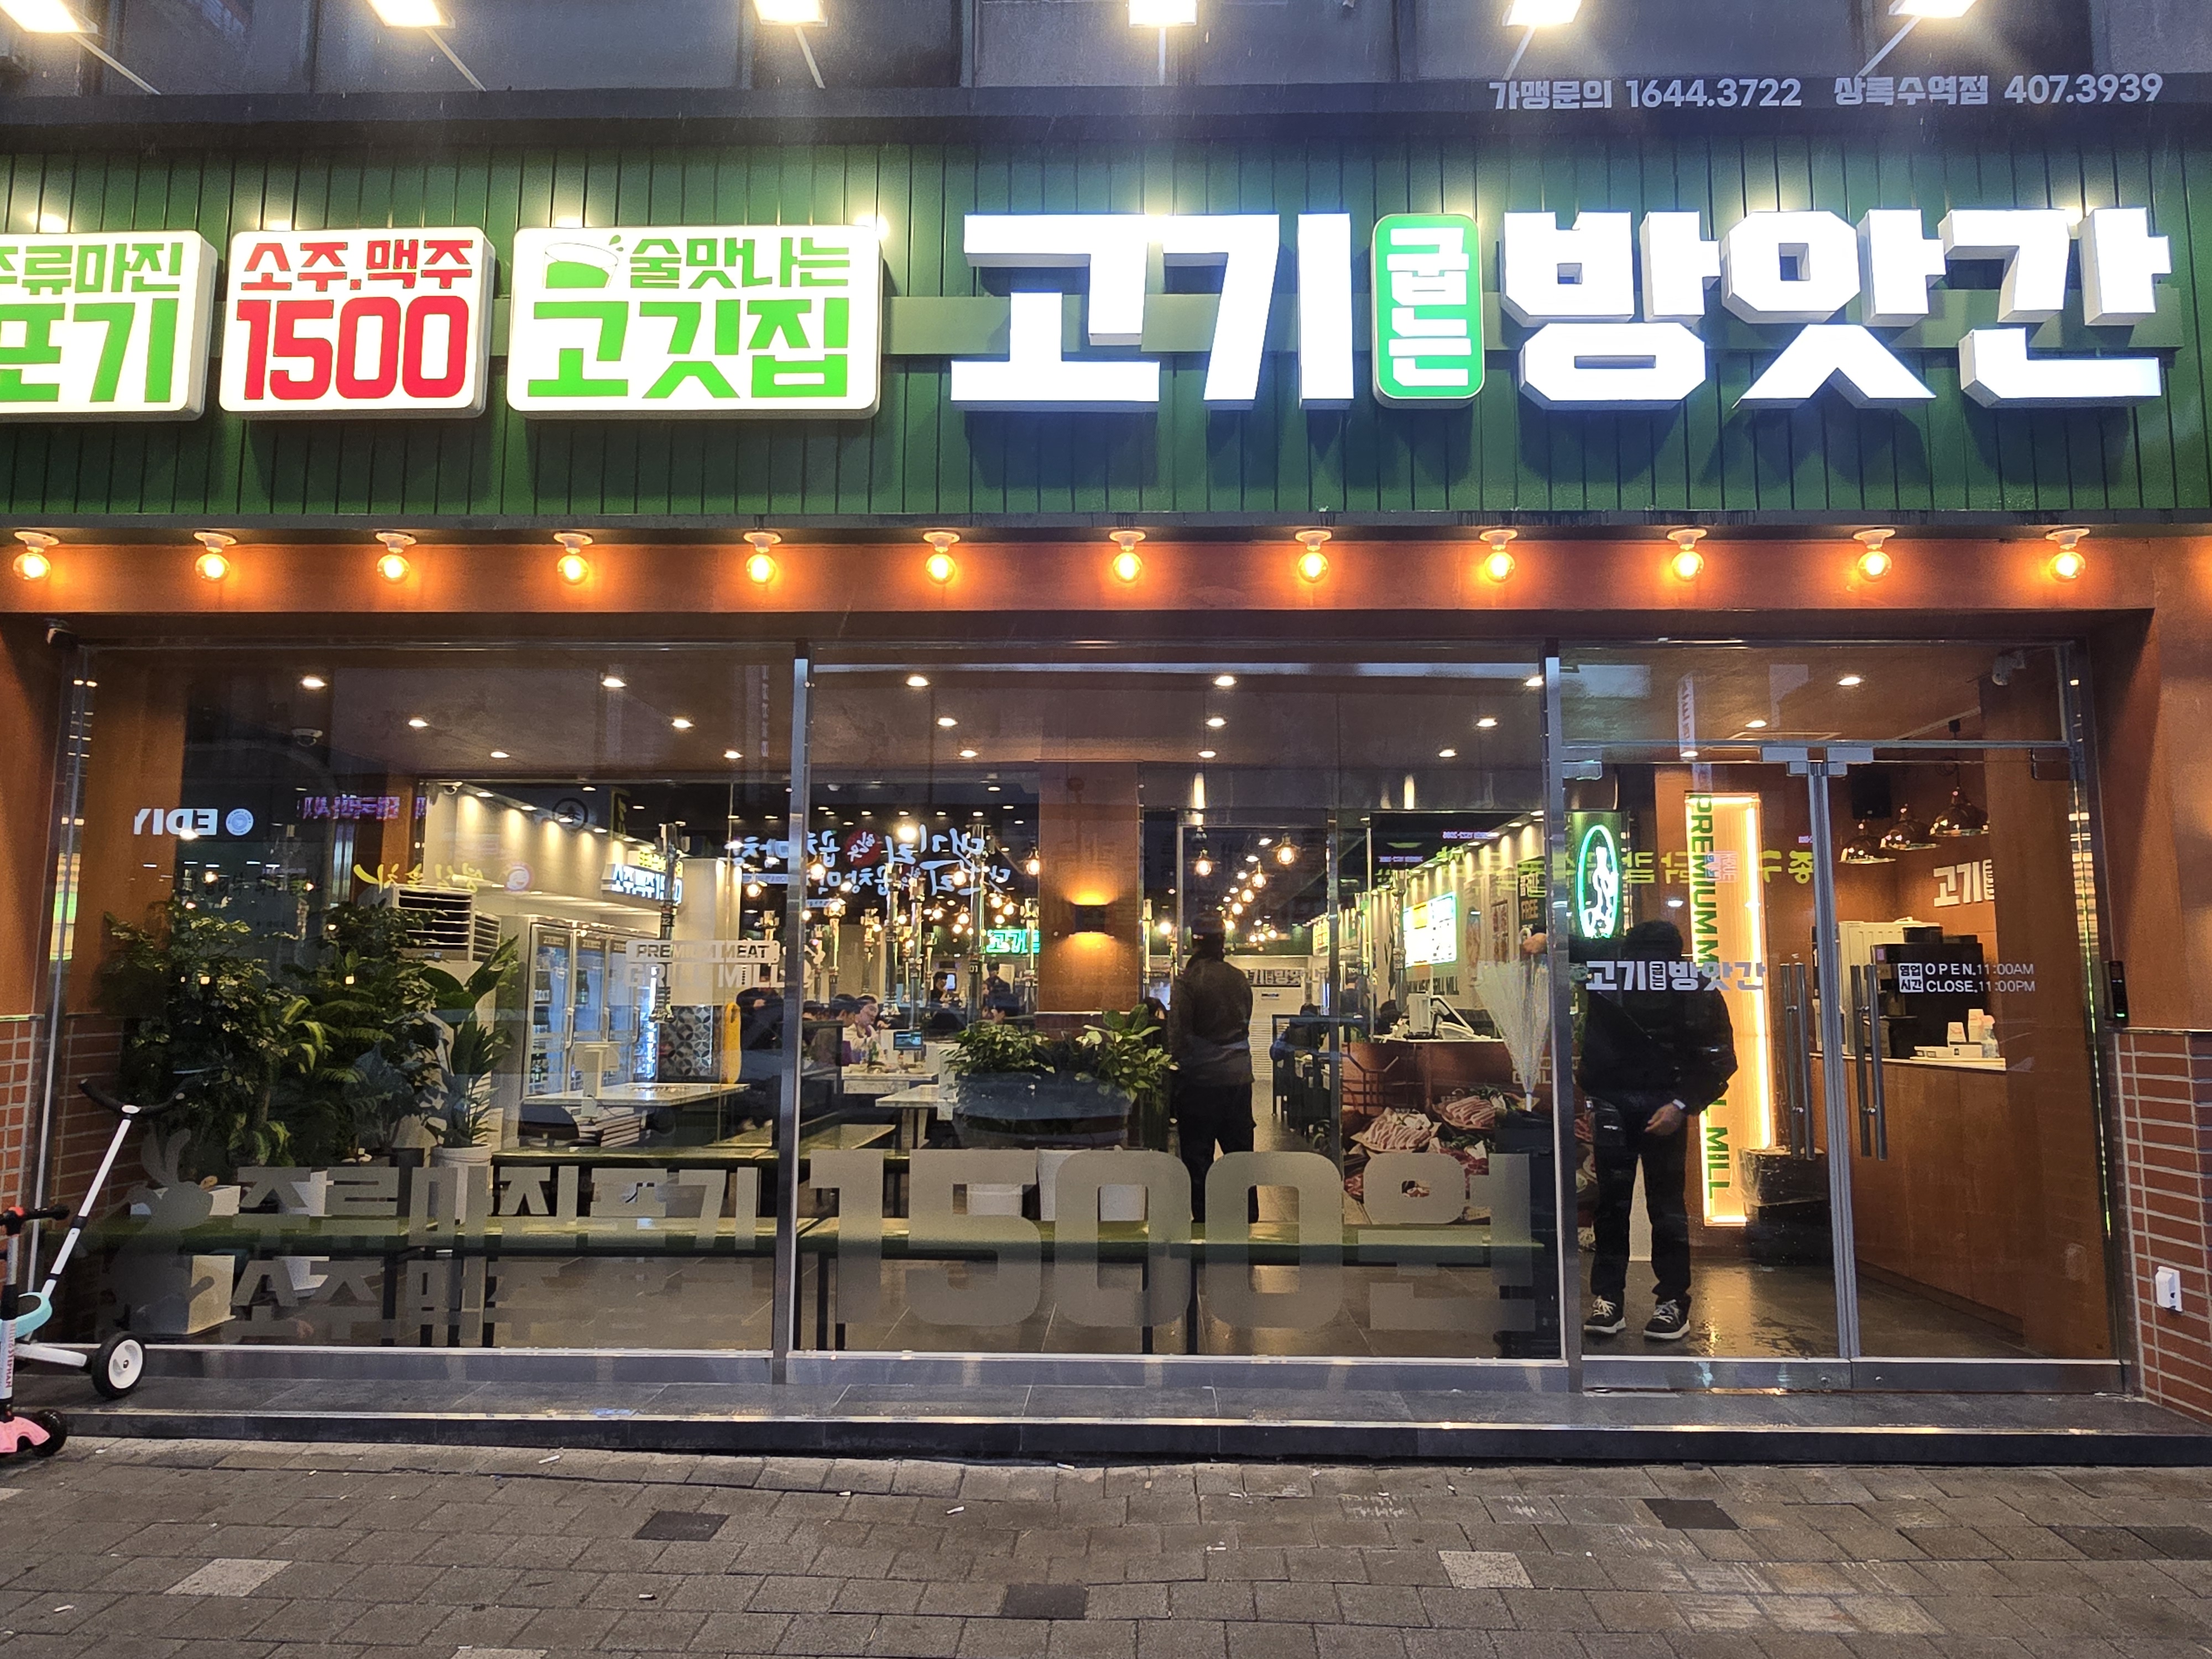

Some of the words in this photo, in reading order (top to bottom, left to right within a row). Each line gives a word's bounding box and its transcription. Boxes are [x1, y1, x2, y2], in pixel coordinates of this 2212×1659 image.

[1489, 80, 1612, 109] 가맹문의
[1626, 78, 1802, 107] 1644.3722
[1834, 75, 1989, 106] 상록수역점
[2004, 73, 2163, 104] 407.3939
[630, 237, 850, 289] 술맛나는
[951, 213, 1354, 403] 고기
[1386, 227, 1472, 387] 굽는
[1502, 208, 2172, 404] 방앗간
[236, 295, 469, 400] 1500
[527, 297, 850, 399] 고깃집
[1689, 794, 1718, 935] PREMIUM
[1933, 861, 1983, 907] 고기
[721, 945, 769, 958] MEAT
[1585, 961, 1646, 990] 고기
[1668, 961, 1766, 991] 방앗간
[1900, 964, 1921, 977] 영업
[1901, 979, 1922, 990] 시간
[1706, 1126, 1730, 1199] MILL
[809, 1149, 1536, 1332] 1500원
